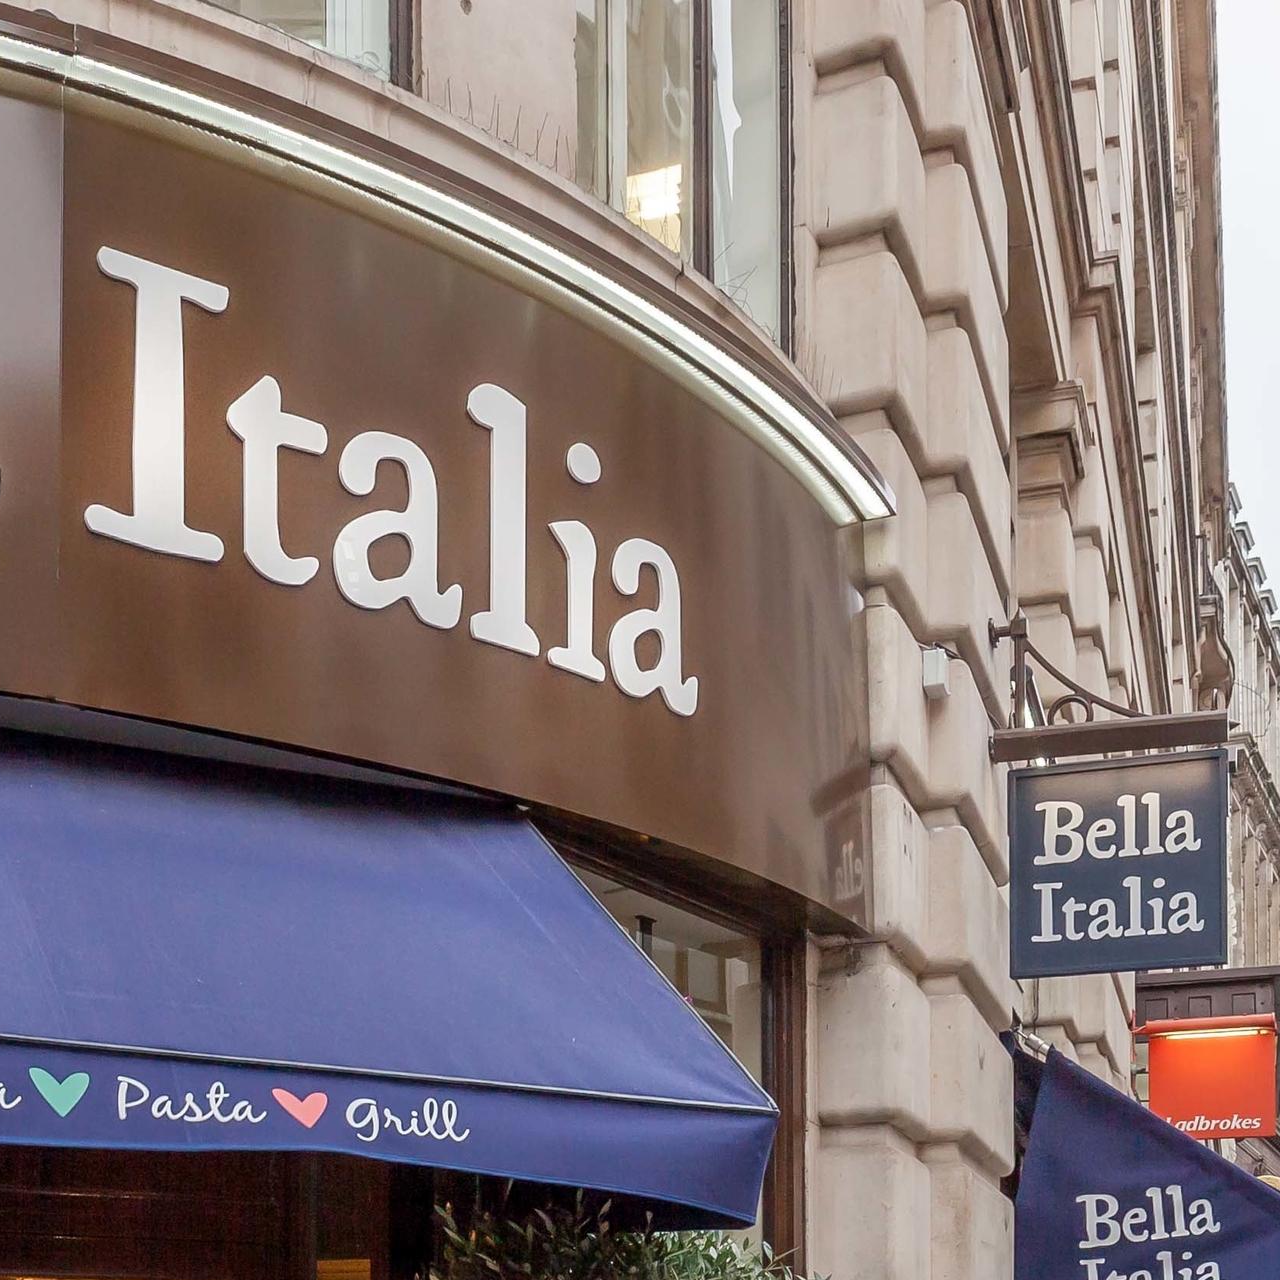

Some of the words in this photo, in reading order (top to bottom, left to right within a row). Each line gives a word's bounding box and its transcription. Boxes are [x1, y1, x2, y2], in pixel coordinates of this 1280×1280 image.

[84, 245, 699, 717] Italia
[1032, 791, 1202, 866] Bella
[1030, 875, 1205, 943] Italia
[116, 1075, 267, 1124] Pasta
[1075, 1184, 1220, 1250] Bella
